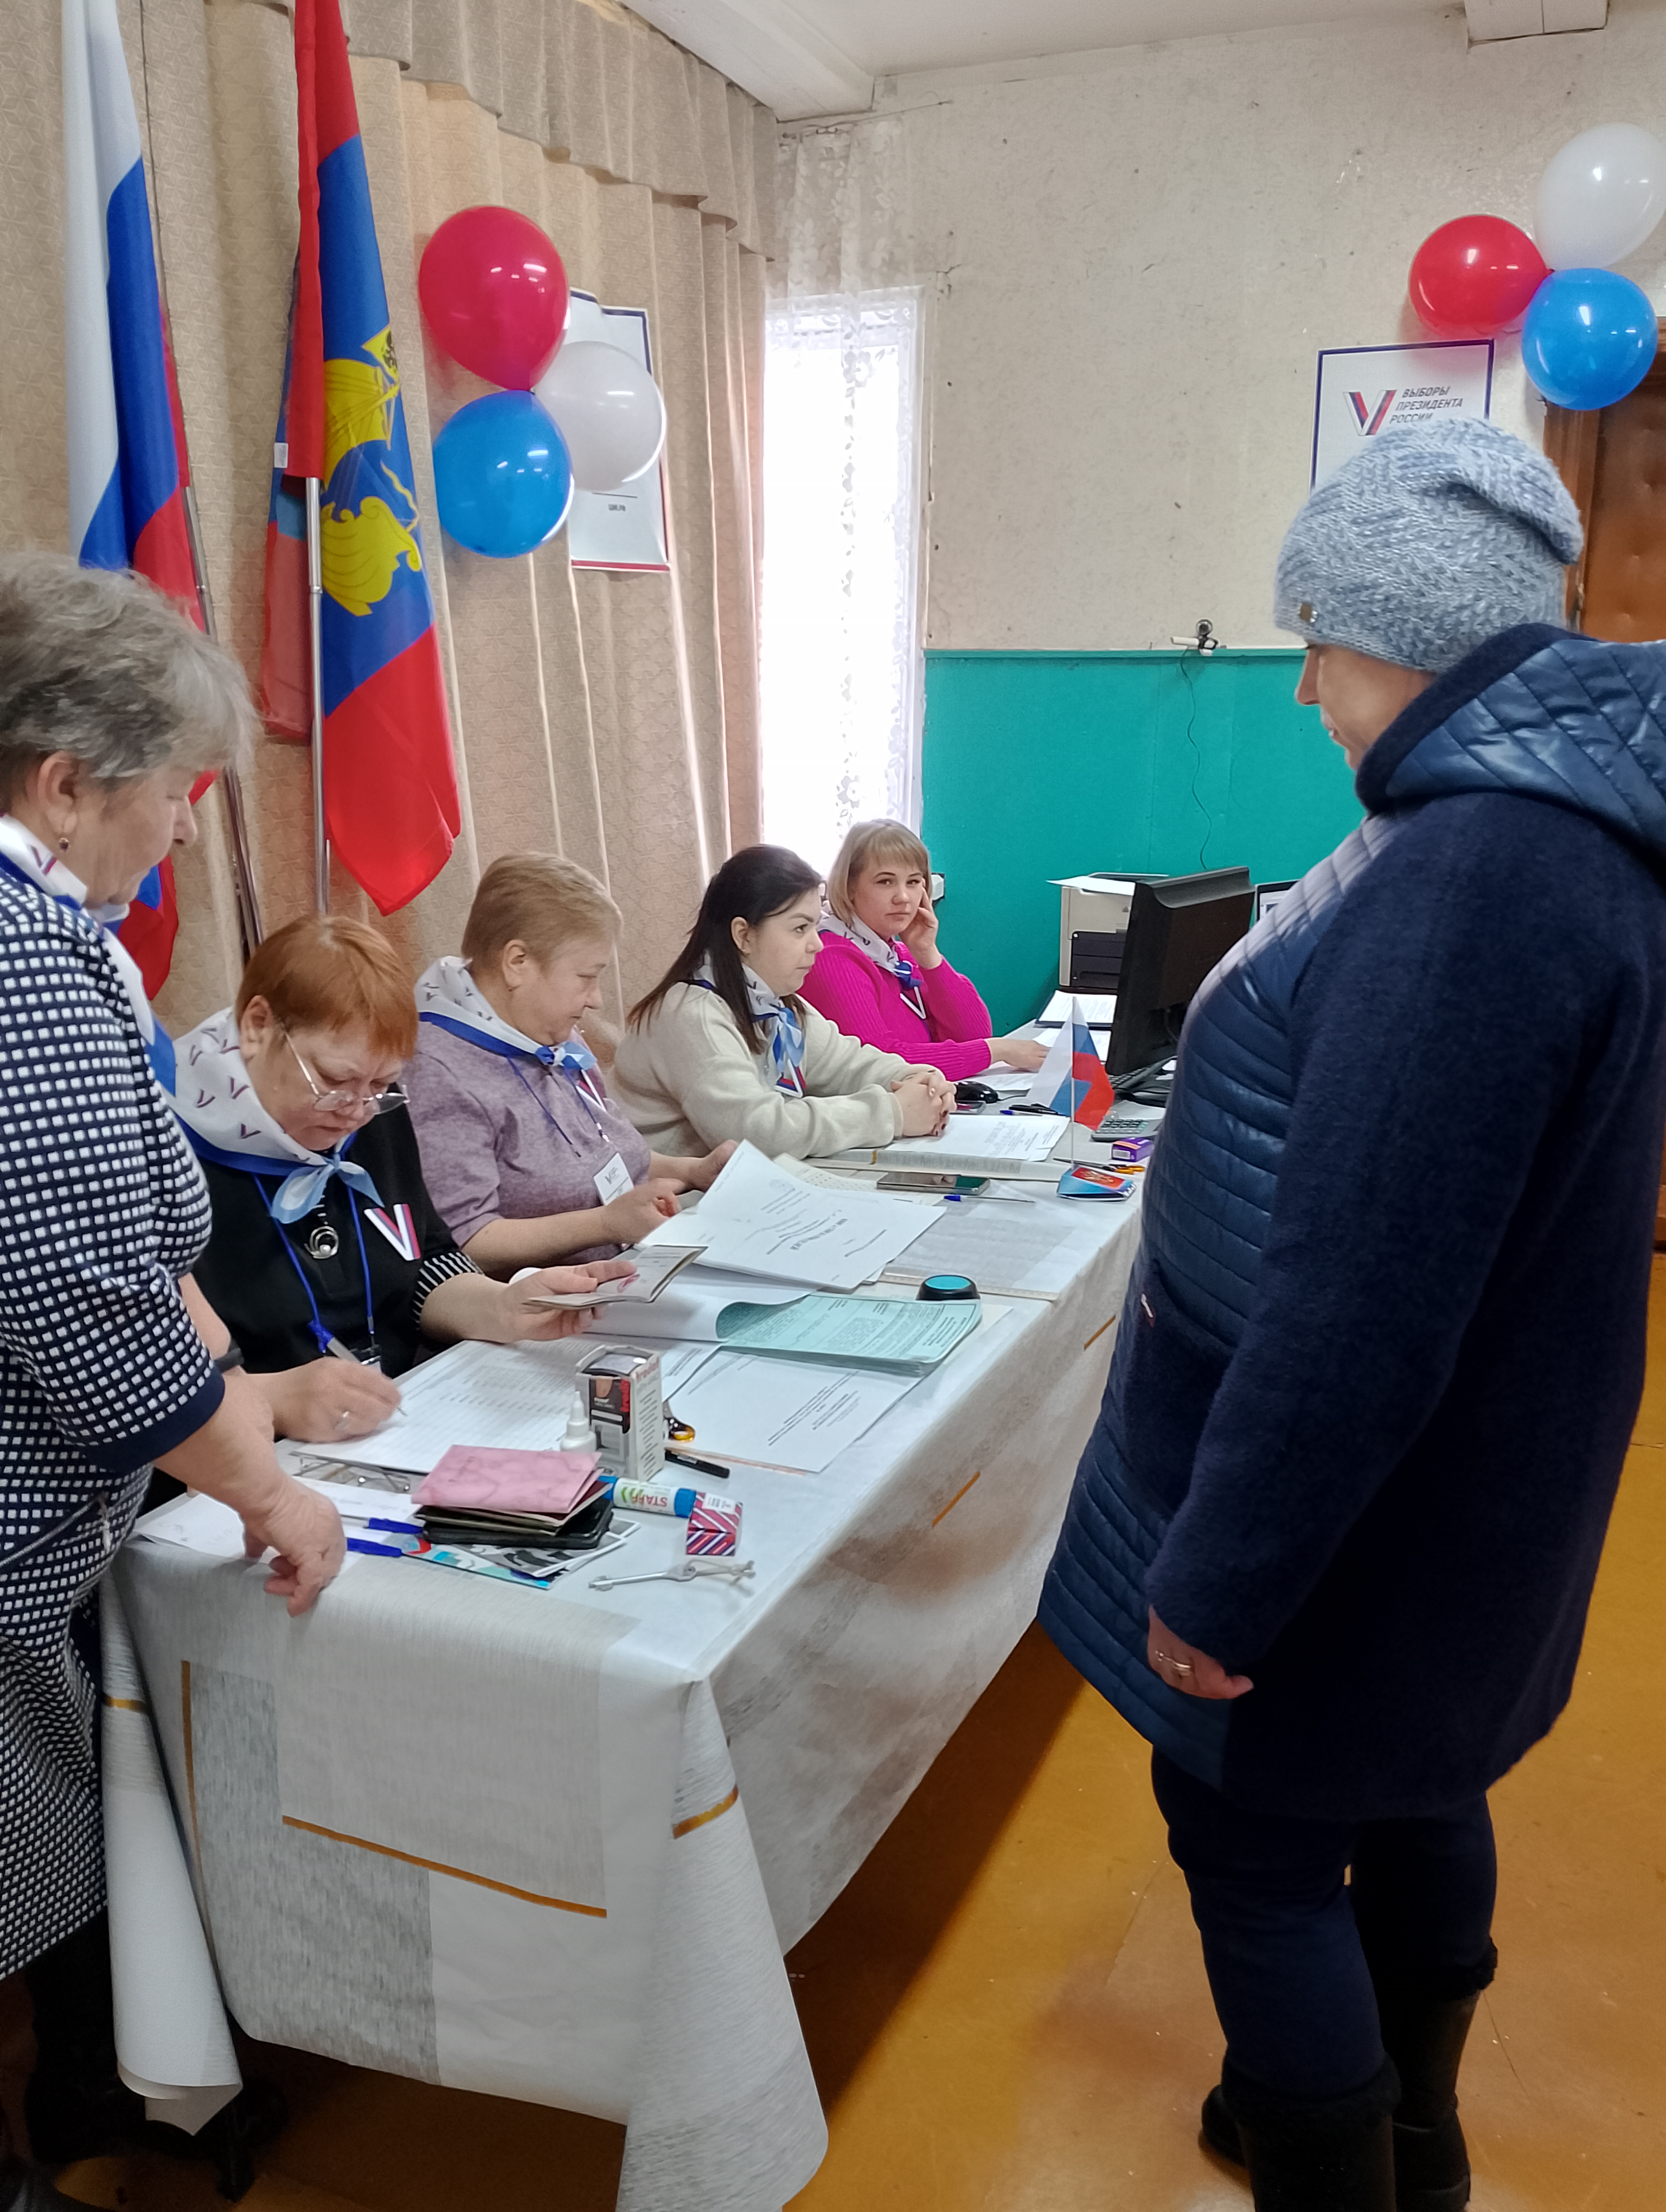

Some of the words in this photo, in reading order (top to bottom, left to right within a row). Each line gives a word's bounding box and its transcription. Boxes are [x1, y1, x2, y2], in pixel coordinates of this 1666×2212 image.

[1402, 386, 1450, 398] ВЫБОРЫ
[1395, 398, 1463, 410] ПРЕЗИДЕНТА
[1389, 413, 1433, 423] РОССИИ
[632, 1494, 668, 1507] STAFF
